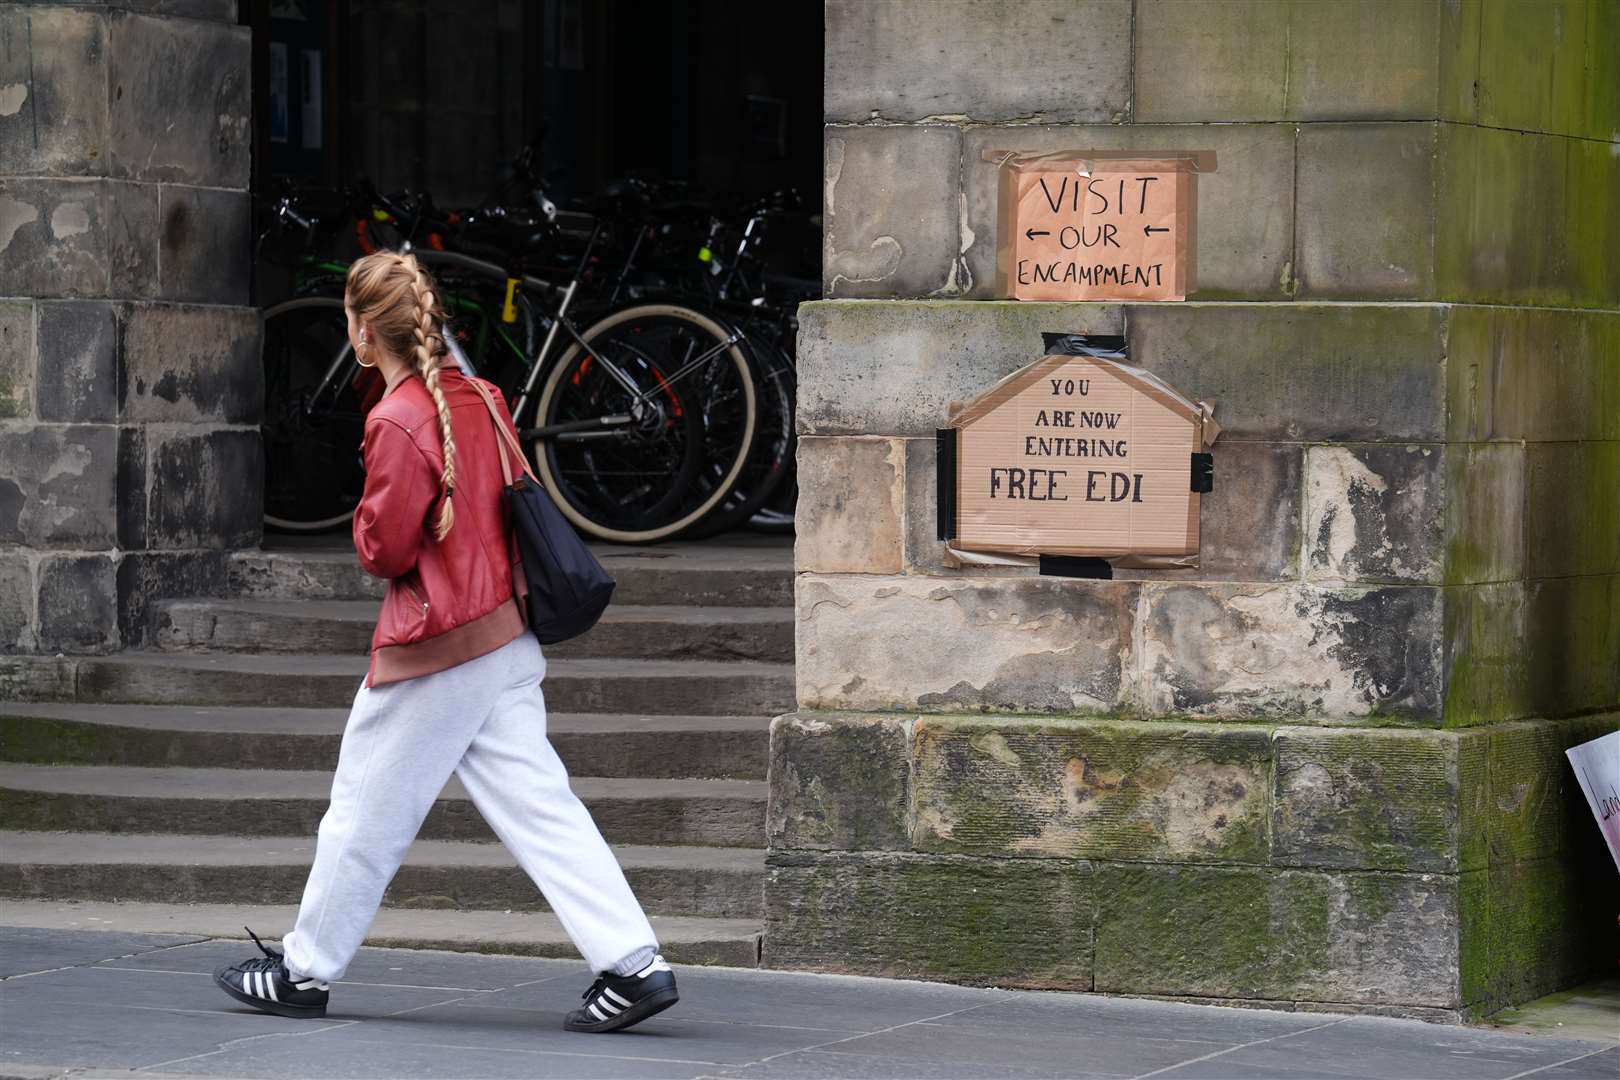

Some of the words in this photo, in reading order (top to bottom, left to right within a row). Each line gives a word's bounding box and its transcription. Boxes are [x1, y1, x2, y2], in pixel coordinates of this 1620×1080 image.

[1039, 176, 1158, 215] VISIT
[1060, 223, 1121, 250] OUR
[1017, 259, 1163, 287] ENCAMPMENT
[1050, 379, 1090, 396] YOU
[1035, 410, 1075, 428] ARE
[1080, 412, 1122, 429] NOW
[1025, 436, 1128, 457] ENTERING
[990, 467, 1068, 501] FREE
[1085, 470, 1143, 503] EDI
